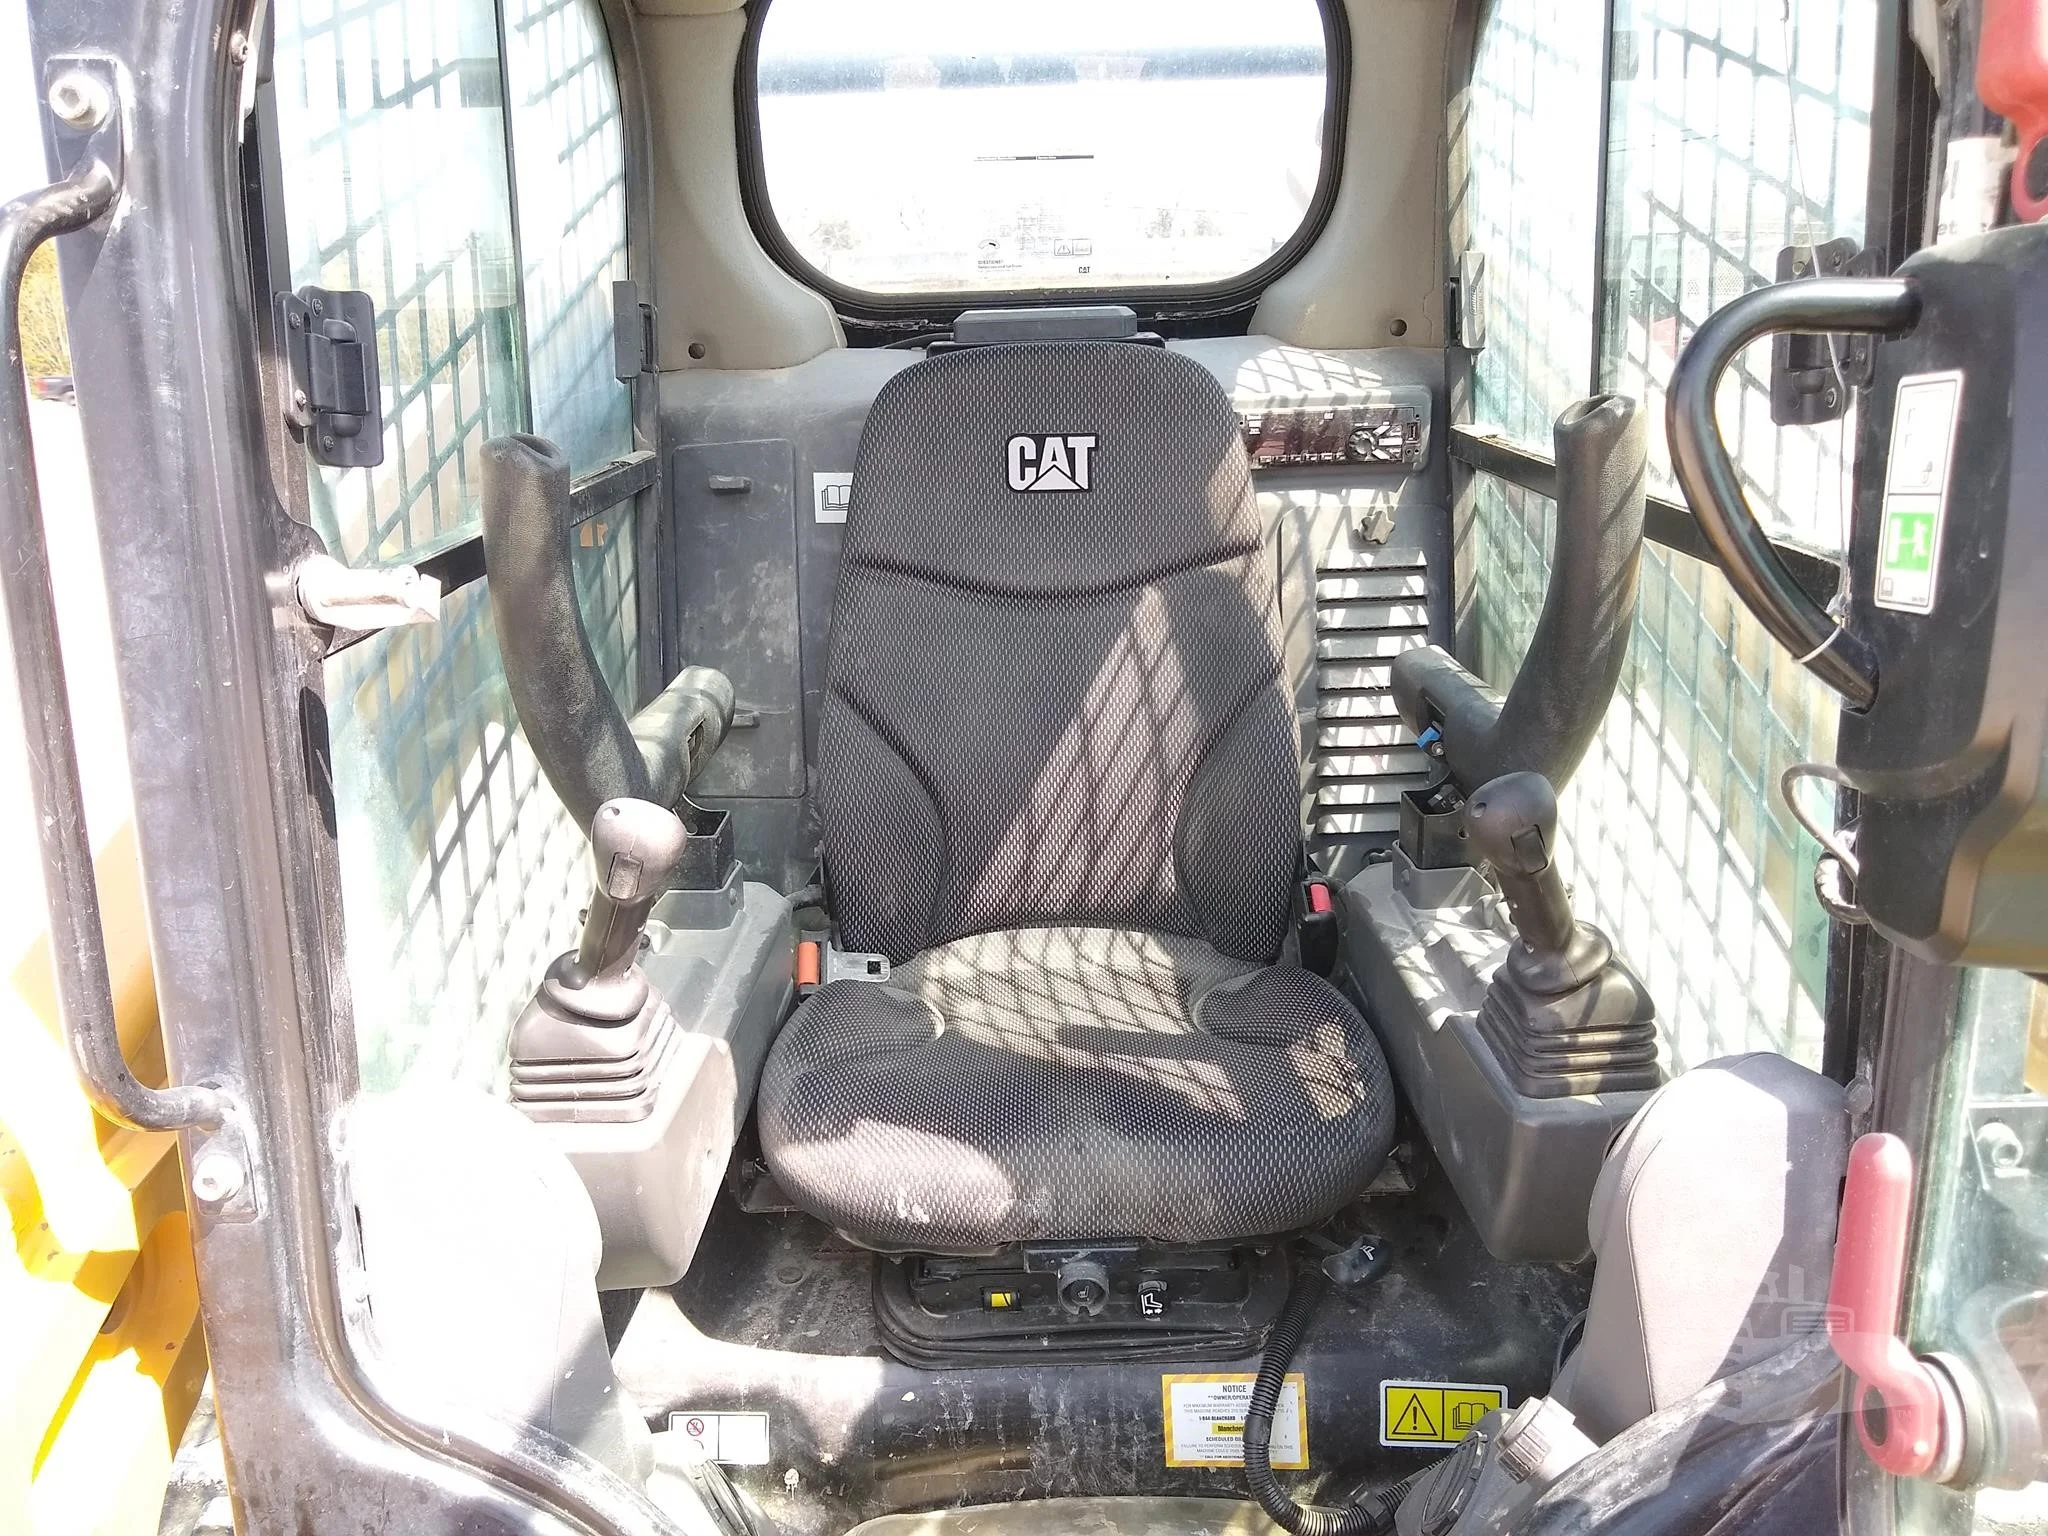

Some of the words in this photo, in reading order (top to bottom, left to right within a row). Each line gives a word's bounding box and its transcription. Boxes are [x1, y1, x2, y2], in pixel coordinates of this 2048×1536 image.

[1078, 266, 1091, 274] CAT
[1007, 435, 1096, 491] CAT
[1222, 1384, 1247, 1393] NOTICE
